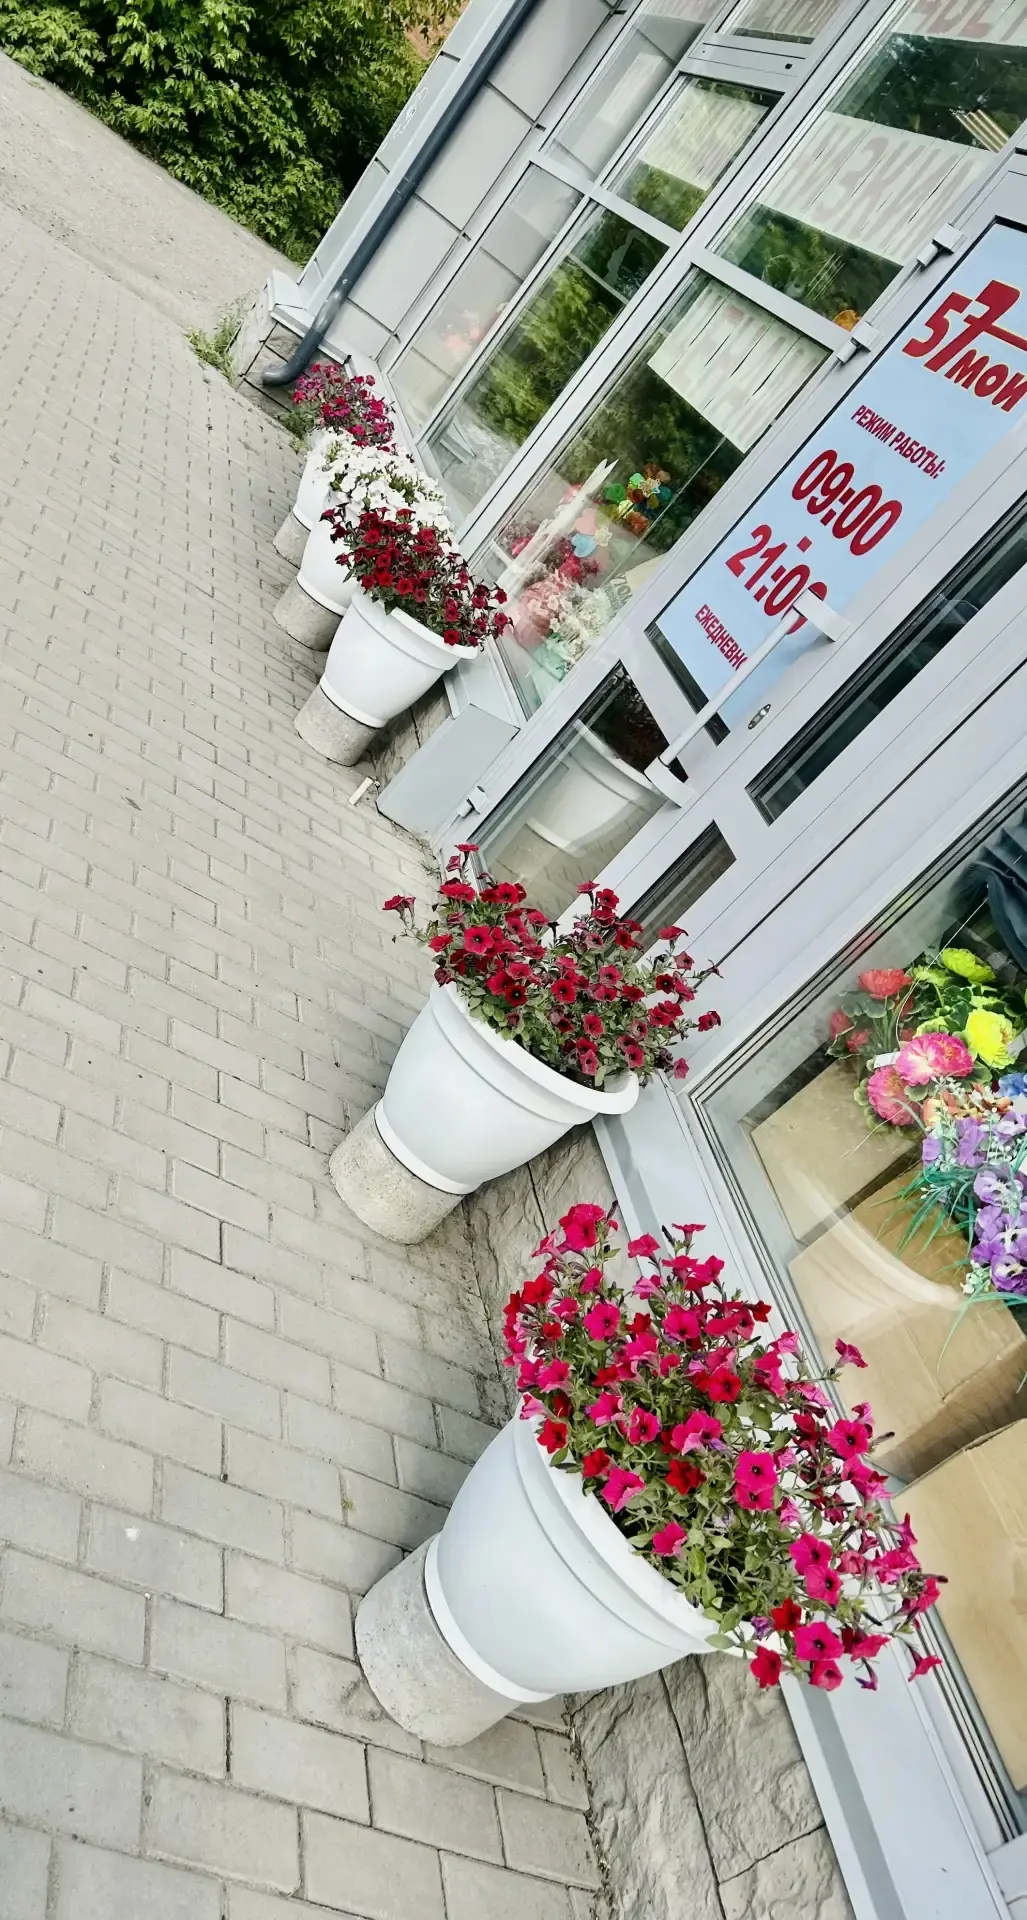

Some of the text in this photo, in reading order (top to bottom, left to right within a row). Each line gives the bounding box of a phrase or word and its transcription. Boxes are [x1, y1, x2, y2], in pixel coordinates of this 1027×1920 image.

[851, 405, 946, 479] РЕЖИМ РАБОТЫ:
[792, 450, 902, 556] 09:00
